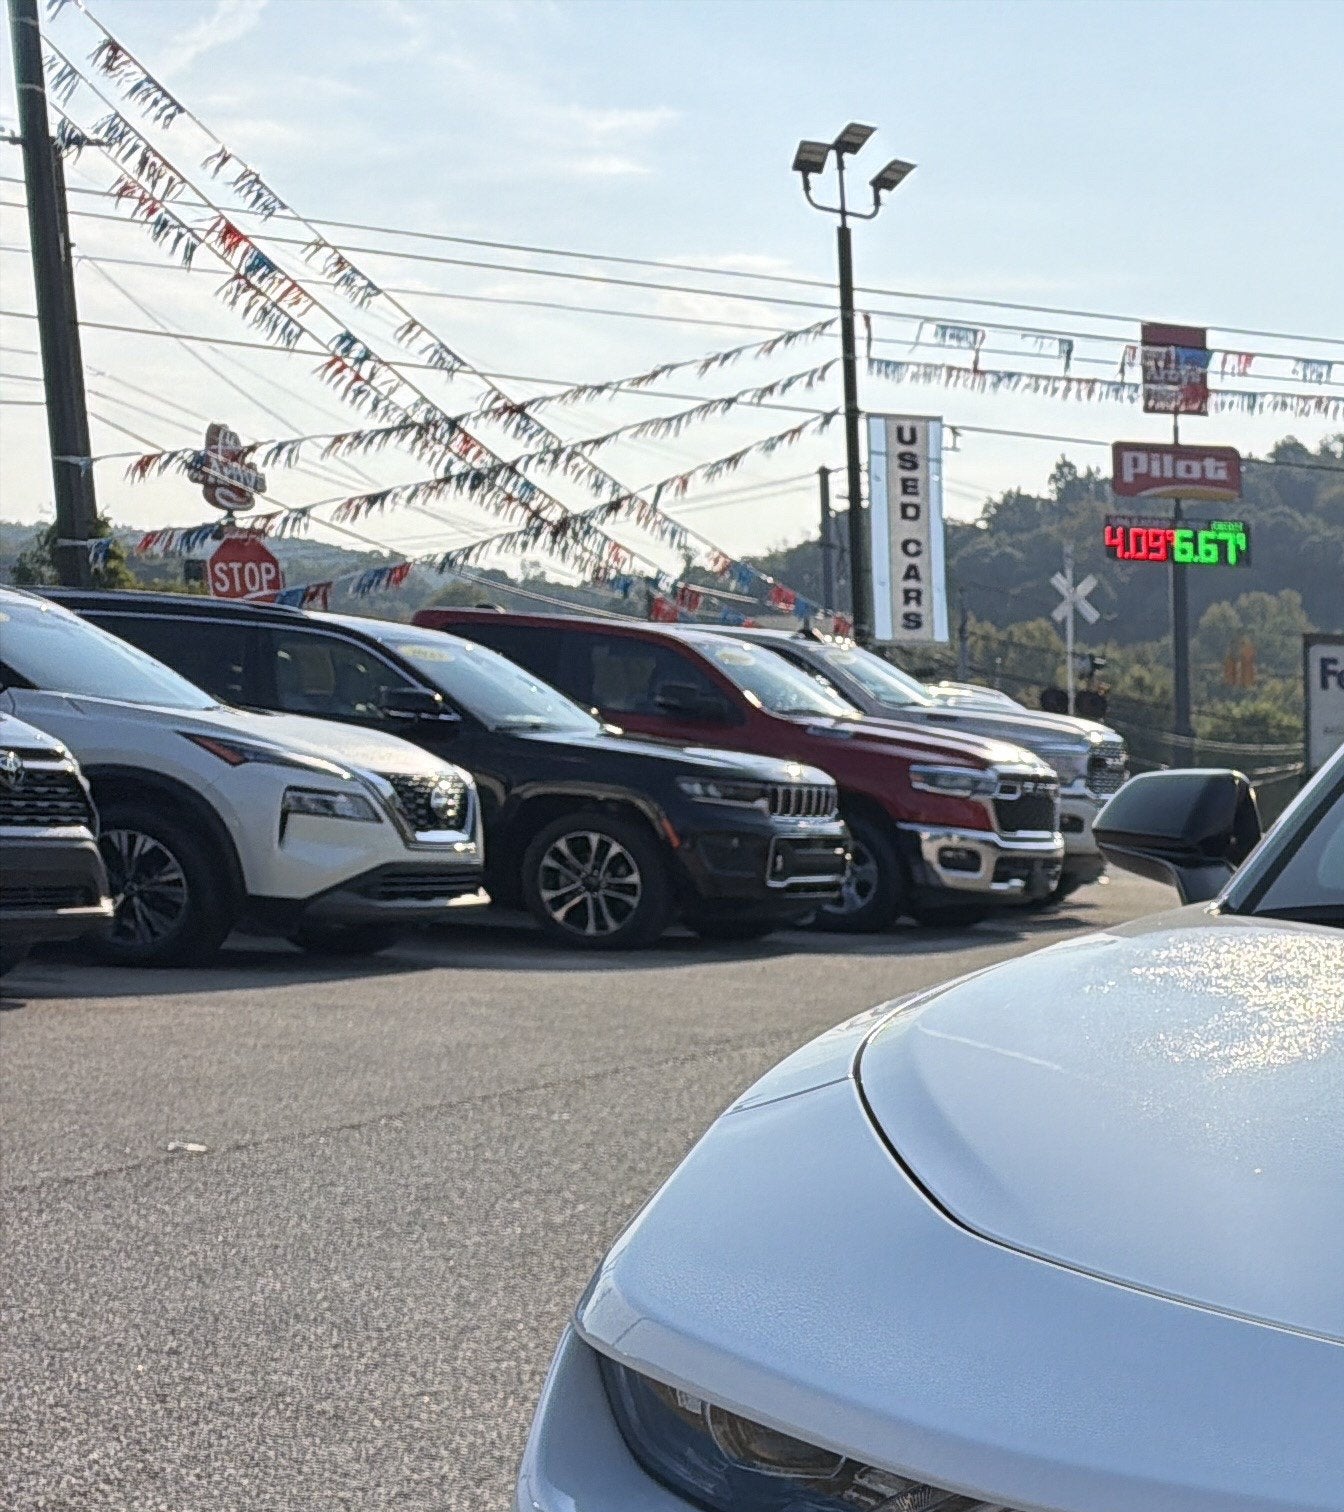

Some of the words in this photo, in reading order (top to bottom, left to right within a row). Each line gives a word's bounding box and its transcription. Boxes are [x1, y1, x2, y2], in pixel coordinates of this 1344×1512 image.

[897, 424, 921, 521] USED
[1122, 451, 1228, 484] Pilot
[214, 561, 276, 592] STOP
[901, 538, 923, 631] CARS
